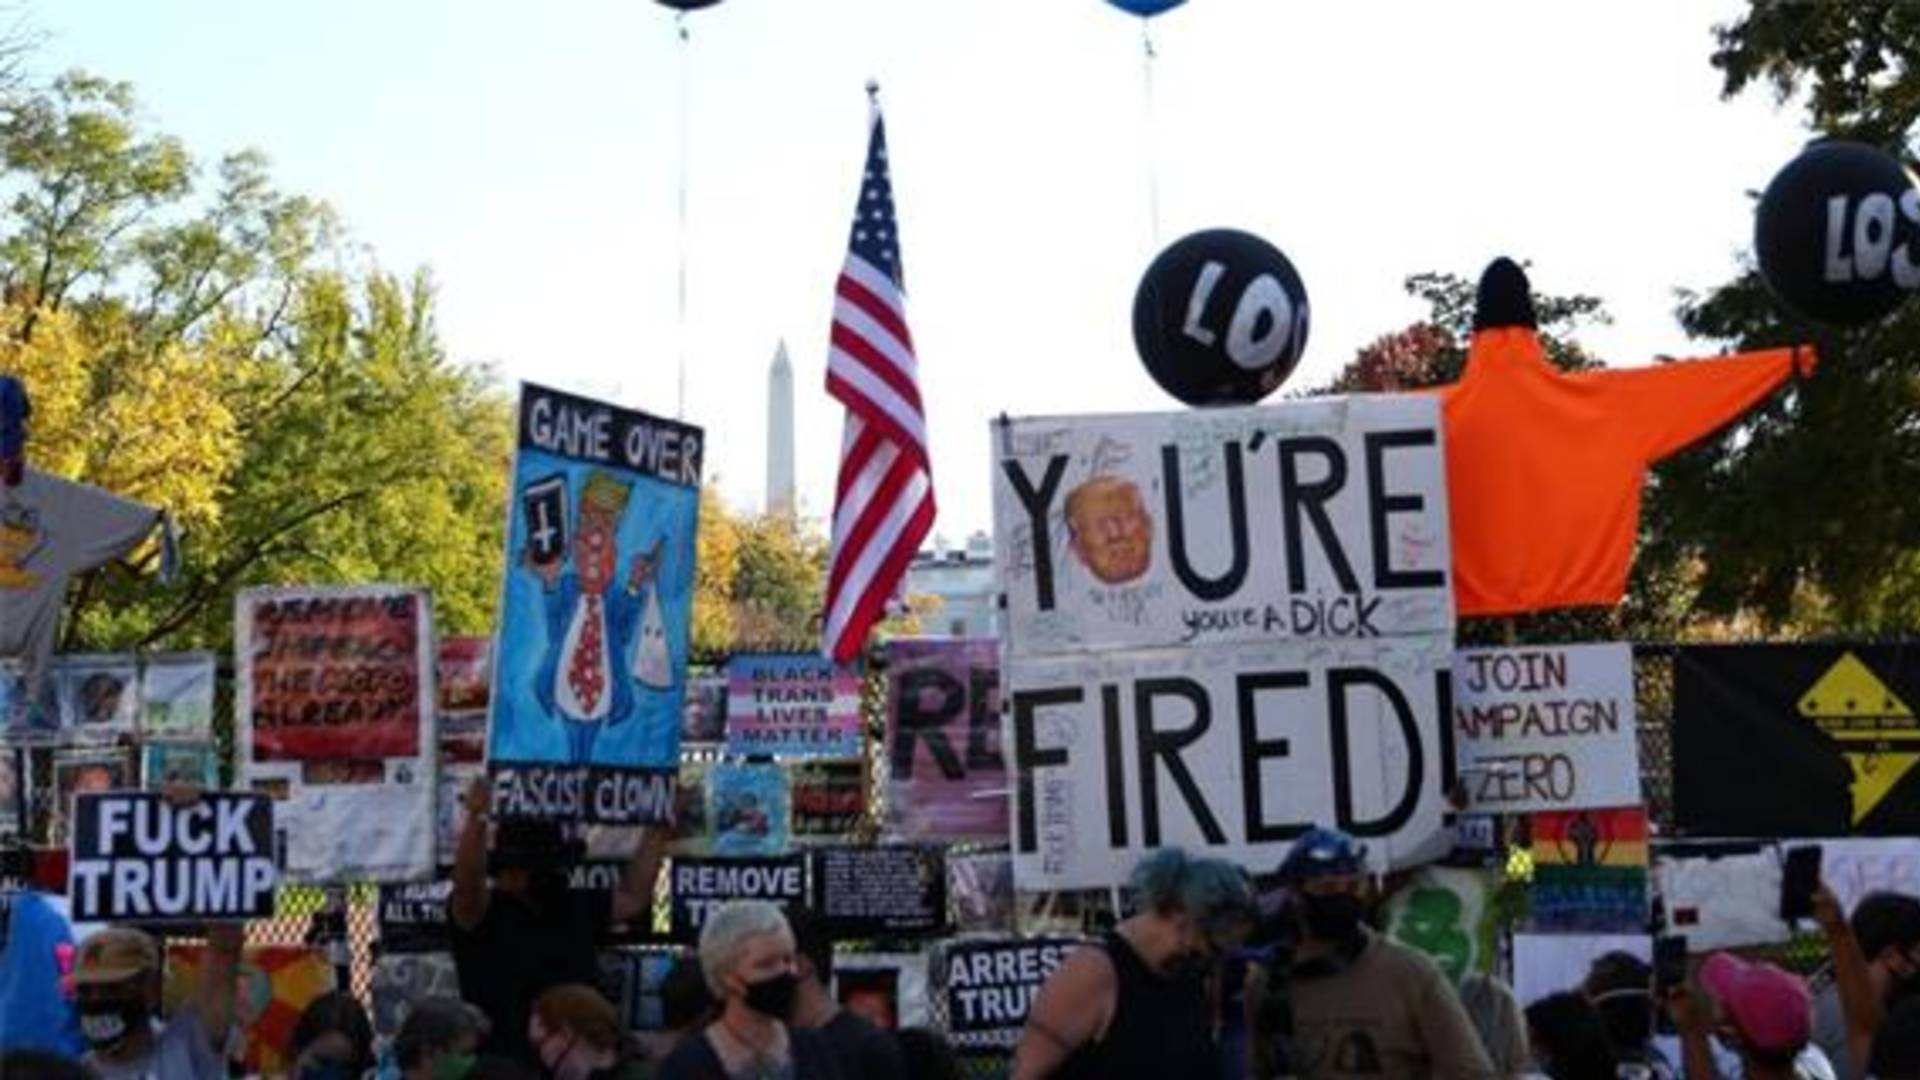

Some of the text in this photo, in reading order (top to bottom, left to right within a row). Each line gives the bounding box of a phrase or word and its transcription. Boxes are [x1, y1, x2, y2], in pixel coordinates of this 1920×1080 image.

[1182, 259, 1306, 370] LO
[529, 397, 700, 486] GAME OVER
[1263, 604, 1286, 632] A
[752, 668, 831, 682] BLACK
[1467, 652, 1567, 692] JOIN
[754, 687, 834, 702] TRANS
[757, 708, 828, 723] LIVES
[1457, 700, 1618, 738] AMPAIGN
[743, 729, 842, 742] MATTER
[1012, 664, 1458, 856] FIRED!
[1475, 753, 1575, 802] ZERO
[492, 771, 676, 827] FASCIST CLOWN
[99, 799, 255, 854] FUCK
[74, 858, 275, 917] TRUMP
[676, 866, 801, 895] REMOVE
[959, 986, 1040, 1021] TRU
